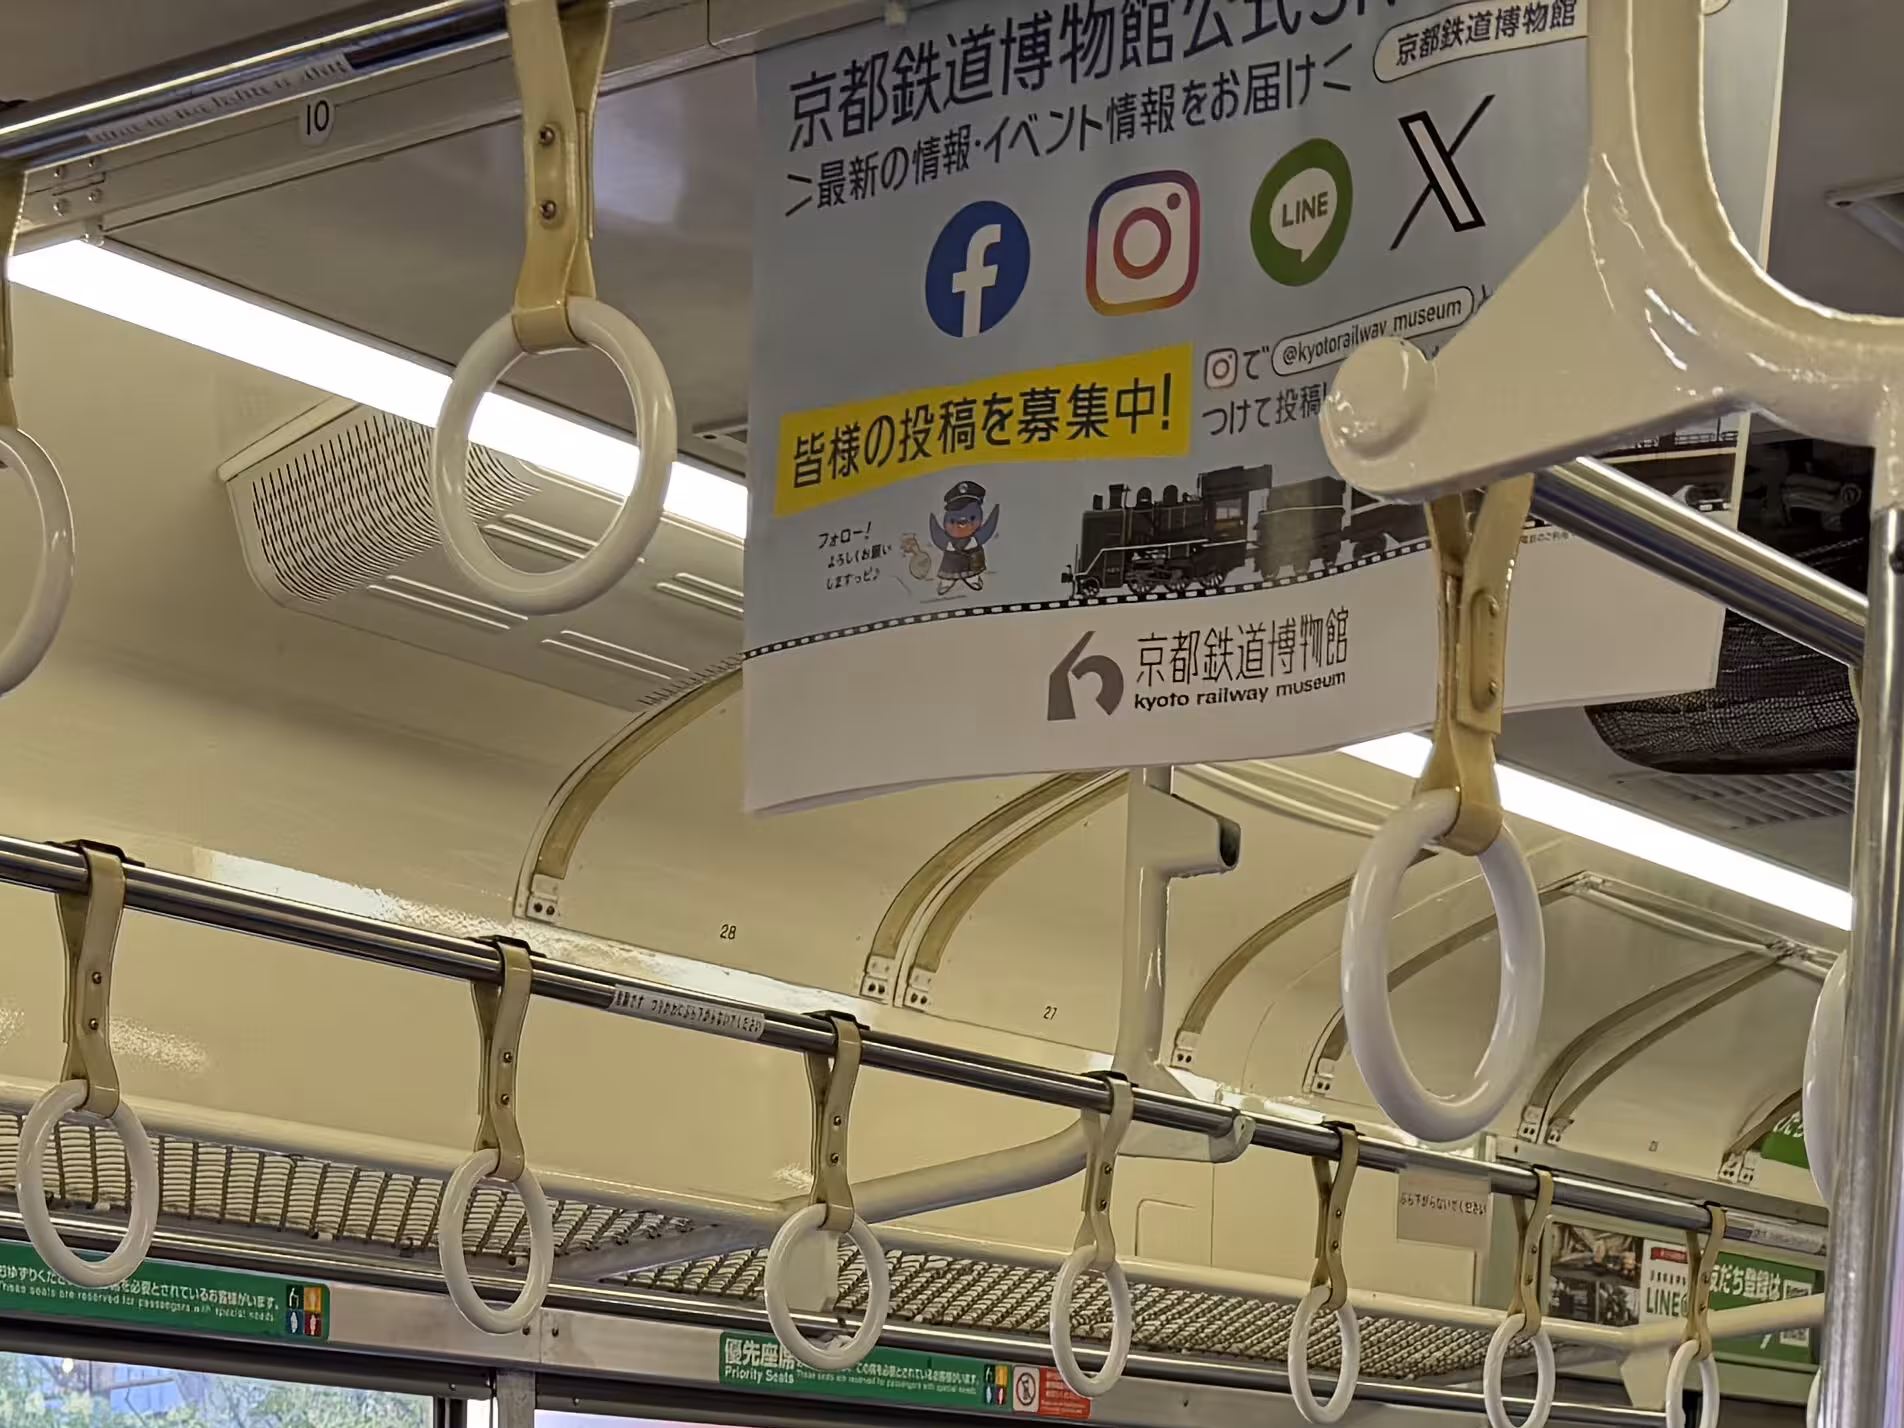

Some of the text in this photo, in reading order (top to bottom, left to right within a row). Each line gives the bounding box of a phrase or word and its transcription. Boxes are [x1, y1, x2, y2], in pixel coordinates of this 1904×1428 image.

[1396, 1, 1577, 66] 京都鉄道博物館
[789, 0, 1395, 152] 京都鉄道博物館公式
[307, 100, 329, 135] 10
[1281, 192, 1329, 228] LINE
[1283, 299, 1462, 365] @kyotorailwaymuseum
[1136, 605, 1349, 687] 京都鉄道博物館
[1134, 671, 1346, 711] kyoto railway museum
[720, 924, 736, 940] 28
[725, 1366, 762, 1384] Priority
[766, 1370, 794, 1383] Seats
